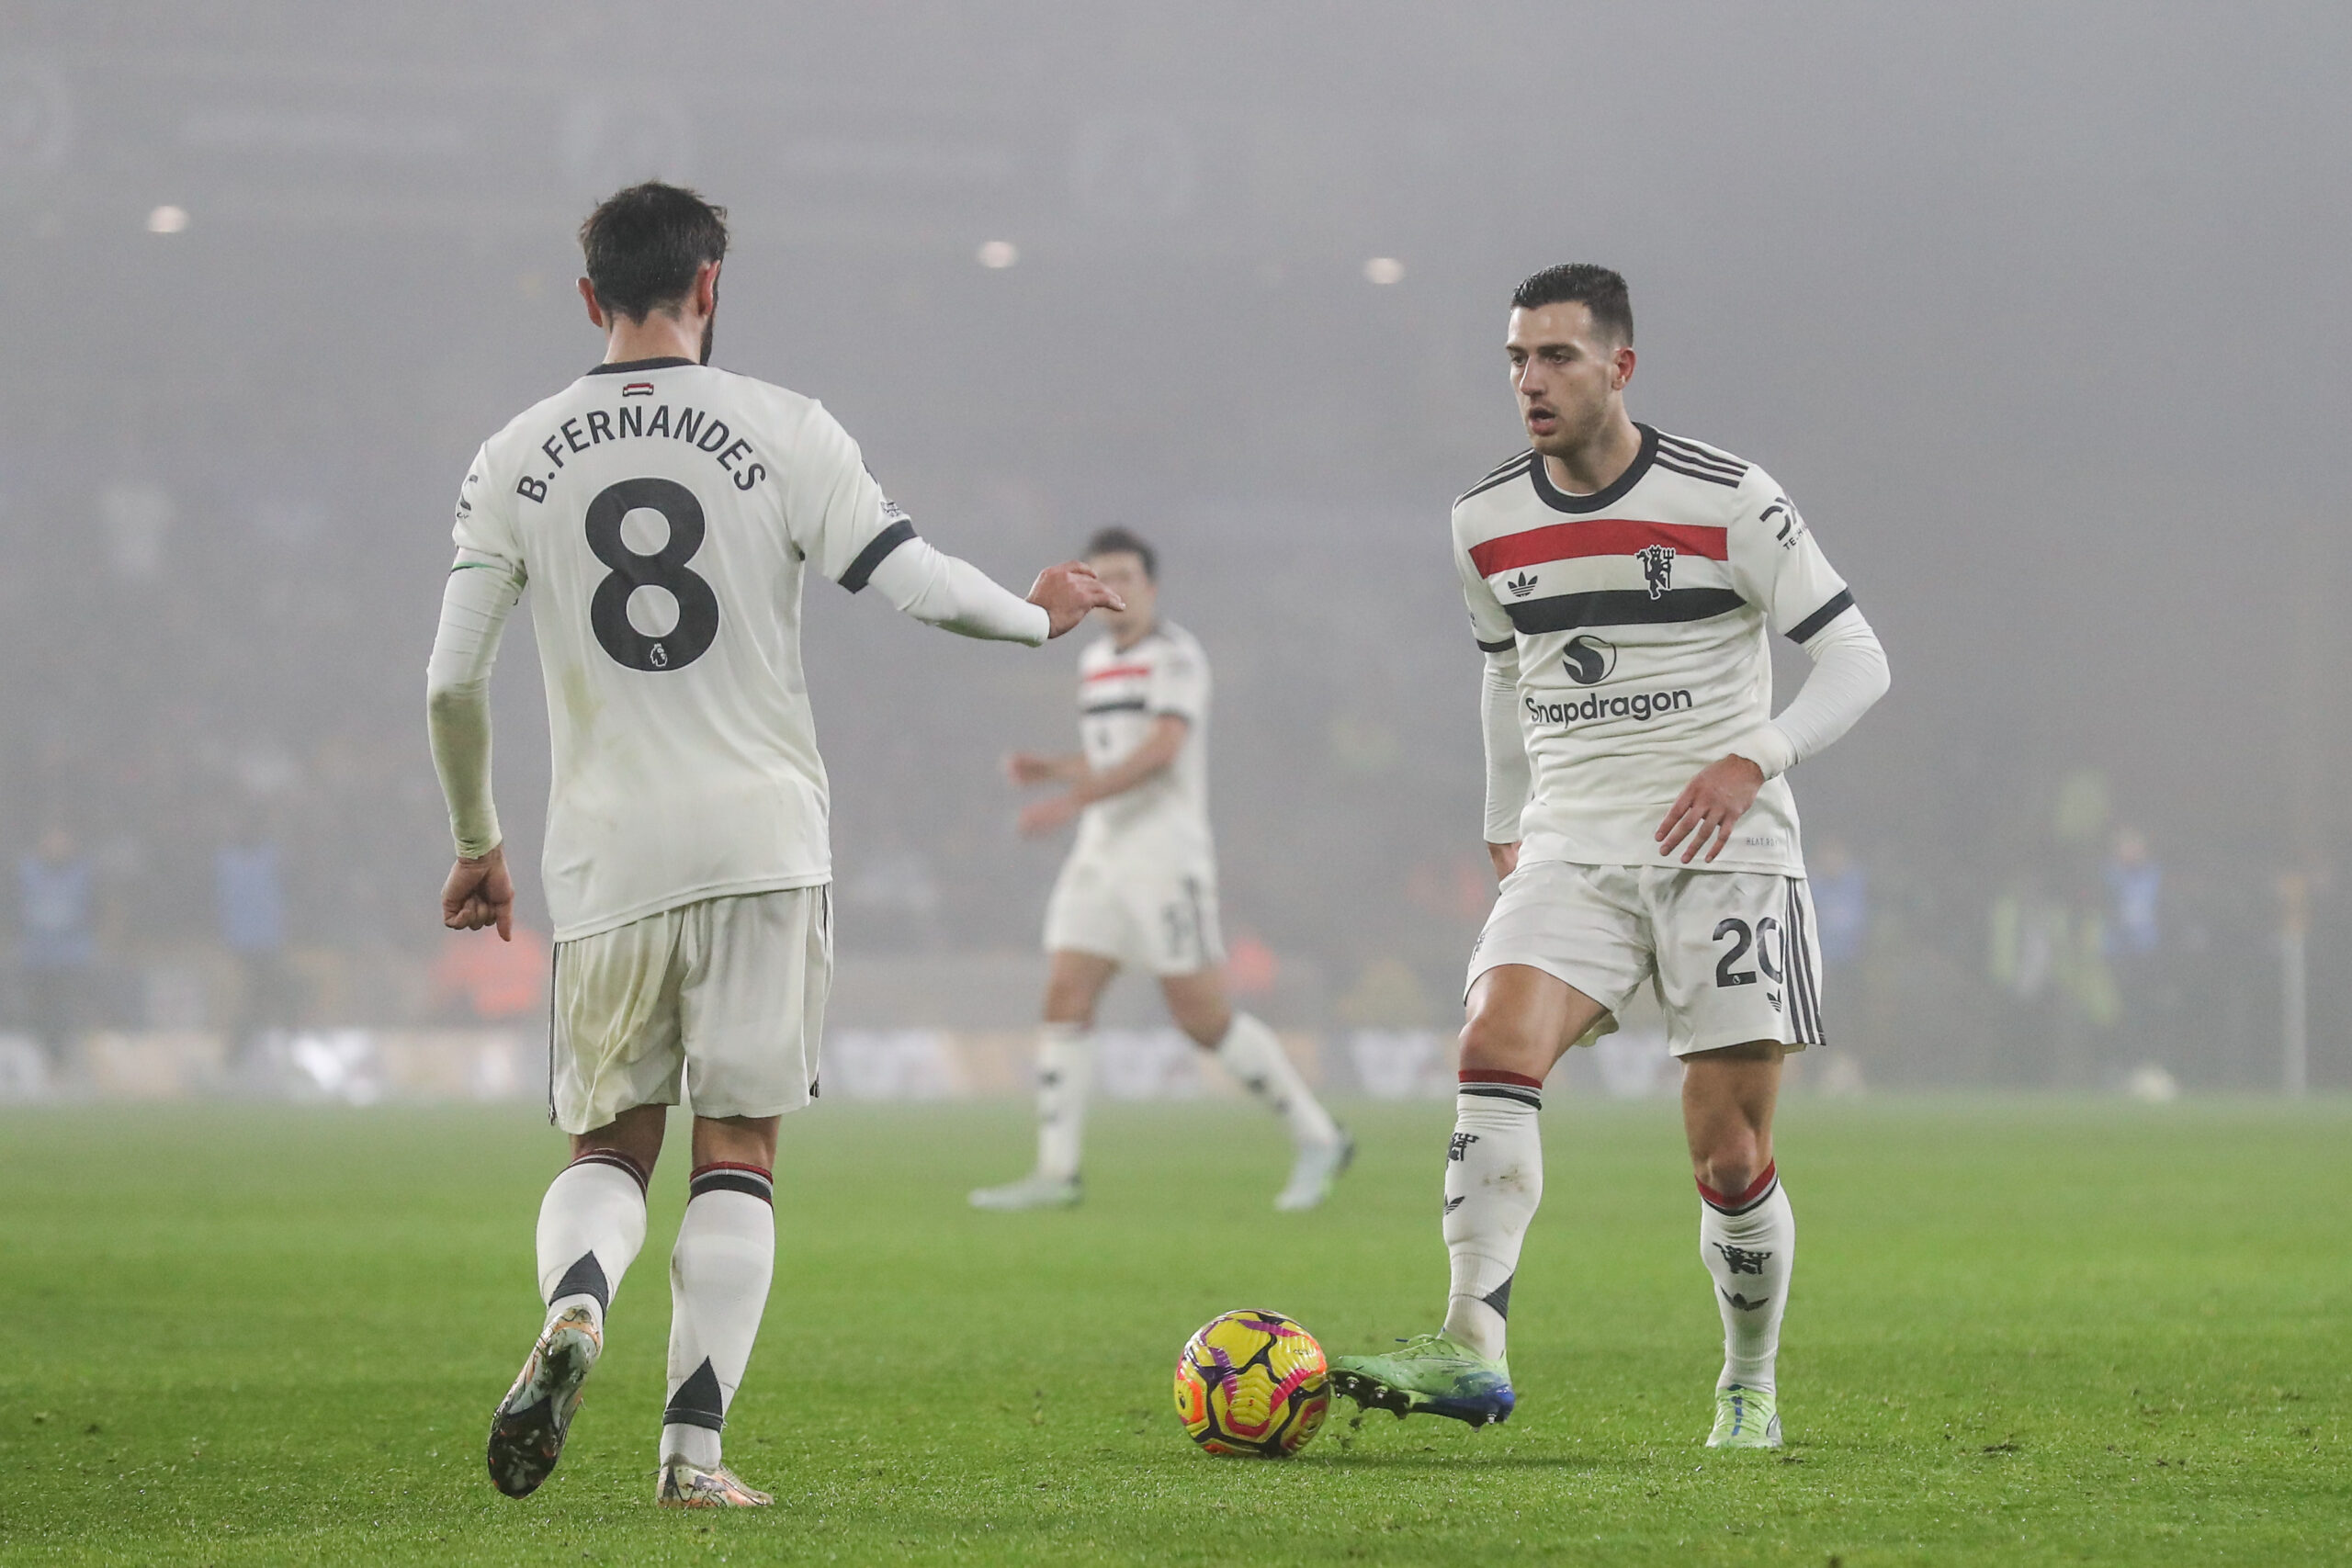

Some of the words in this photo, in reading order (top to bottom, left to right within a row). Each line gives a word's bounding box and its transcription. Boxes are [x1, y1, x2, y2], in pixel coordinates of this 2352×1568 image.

[516, 405, 766, 503] B.FERNANDES
[584, 476, 719, 672] 8
[1525, 689, 1692, 729] Snapdragon
[1712, 917, 1785, 987] 20
